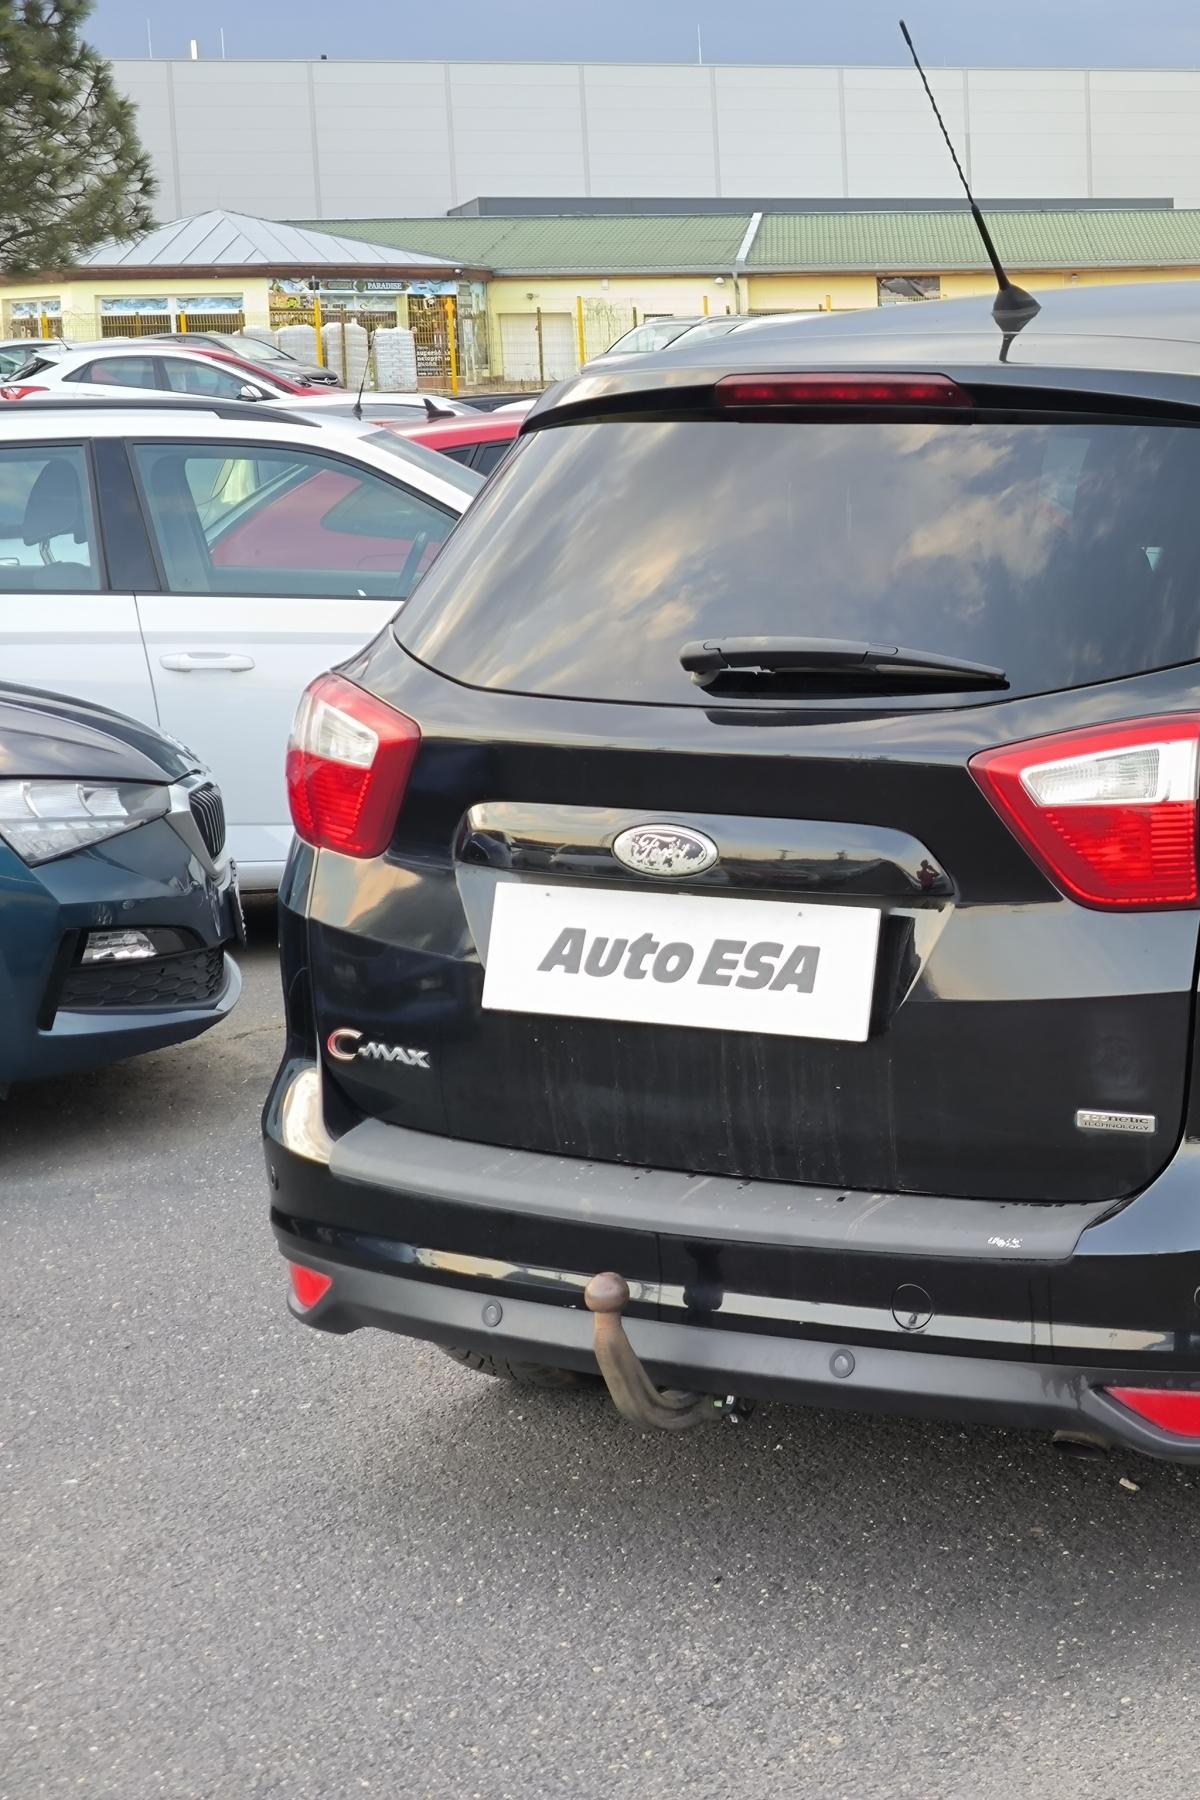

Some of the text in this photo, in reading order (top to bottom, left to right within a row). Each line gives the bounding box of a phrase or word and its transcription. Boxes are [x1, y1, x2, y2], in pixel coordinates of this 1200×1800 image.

[367, 282, 402, 290] PARADISE
[537, 927, 821, 994] Auto ESA
